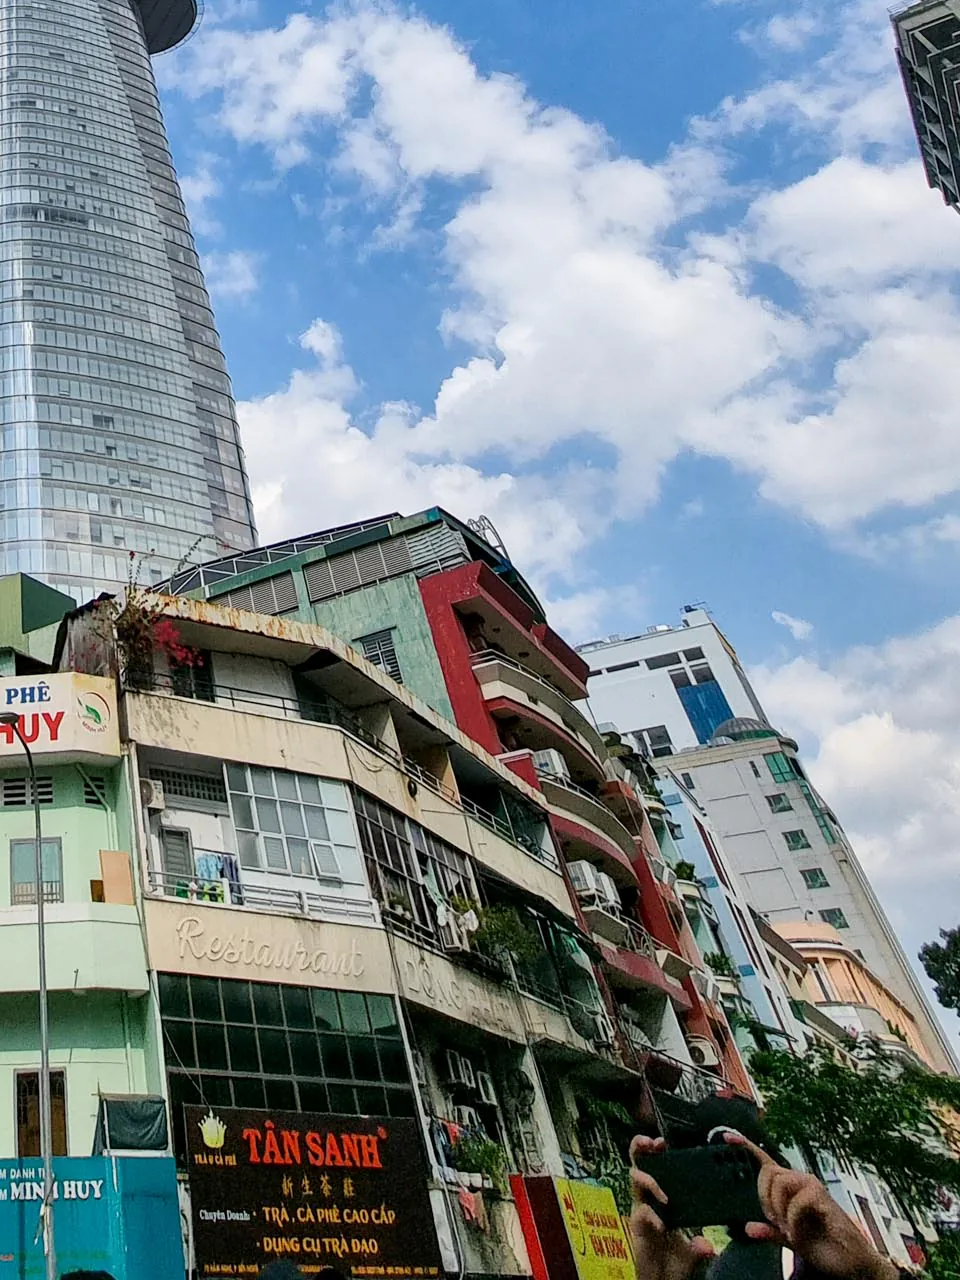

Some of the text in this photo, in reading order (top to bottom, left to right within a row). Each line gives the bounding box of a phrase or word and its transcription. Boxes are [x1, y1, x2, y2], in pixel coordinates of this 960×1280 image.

[5, 680, 51, 705] PHÊ
[176, 916, 365, 978] Restaurant
[242, 1120, 383, 1168] TÂN SANH
[10, 1168, 35, 1179] DANH
[63, 1180, 103, 1200] HUY
[297, 1203, 316, 1222] CÀ
[343, 1208, 369, 1224] CAO
[263, 1237, 300, 1258] DỤNG
[323, 1234, 349, 1259] TRÀ
